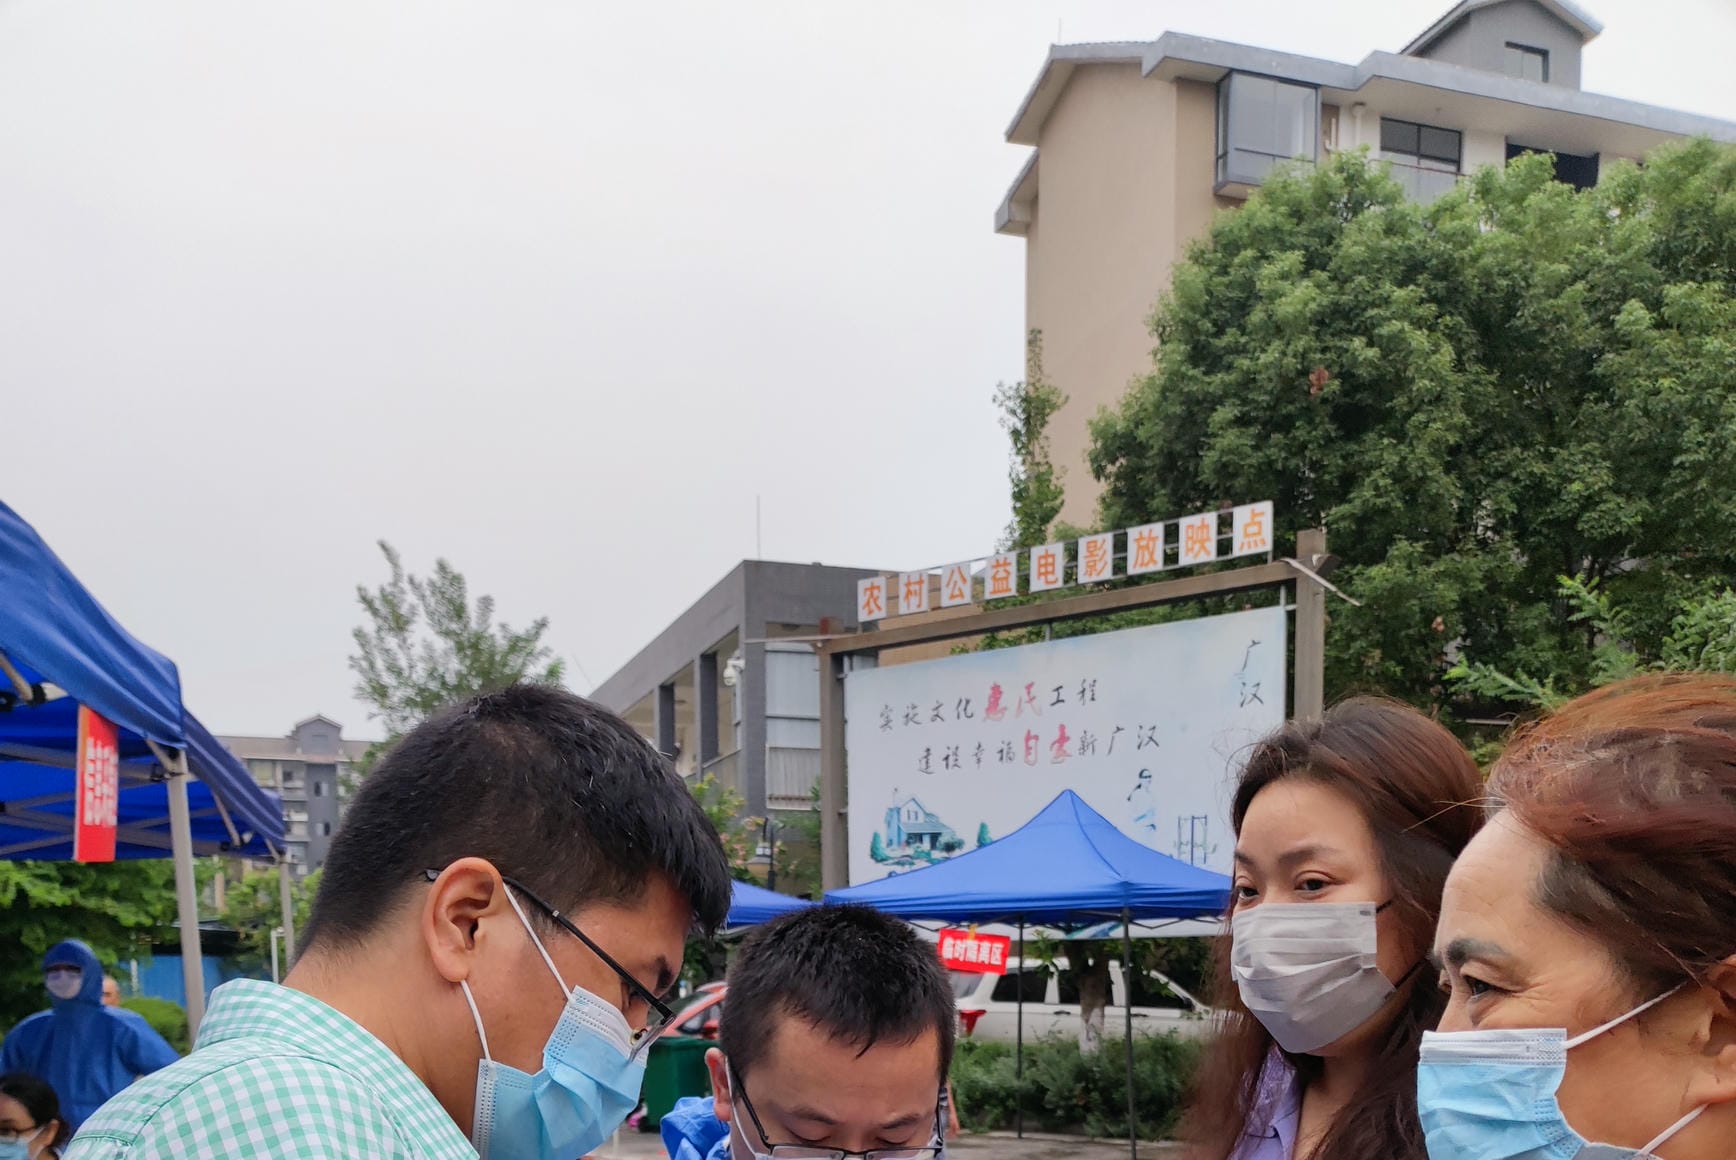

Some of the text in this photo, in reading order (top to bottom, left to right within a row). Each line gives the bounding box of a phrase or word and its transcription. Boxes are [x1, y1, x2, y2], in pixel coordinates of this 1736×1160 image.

[862, 507, 1267, 617] 农村公益电影放映点
